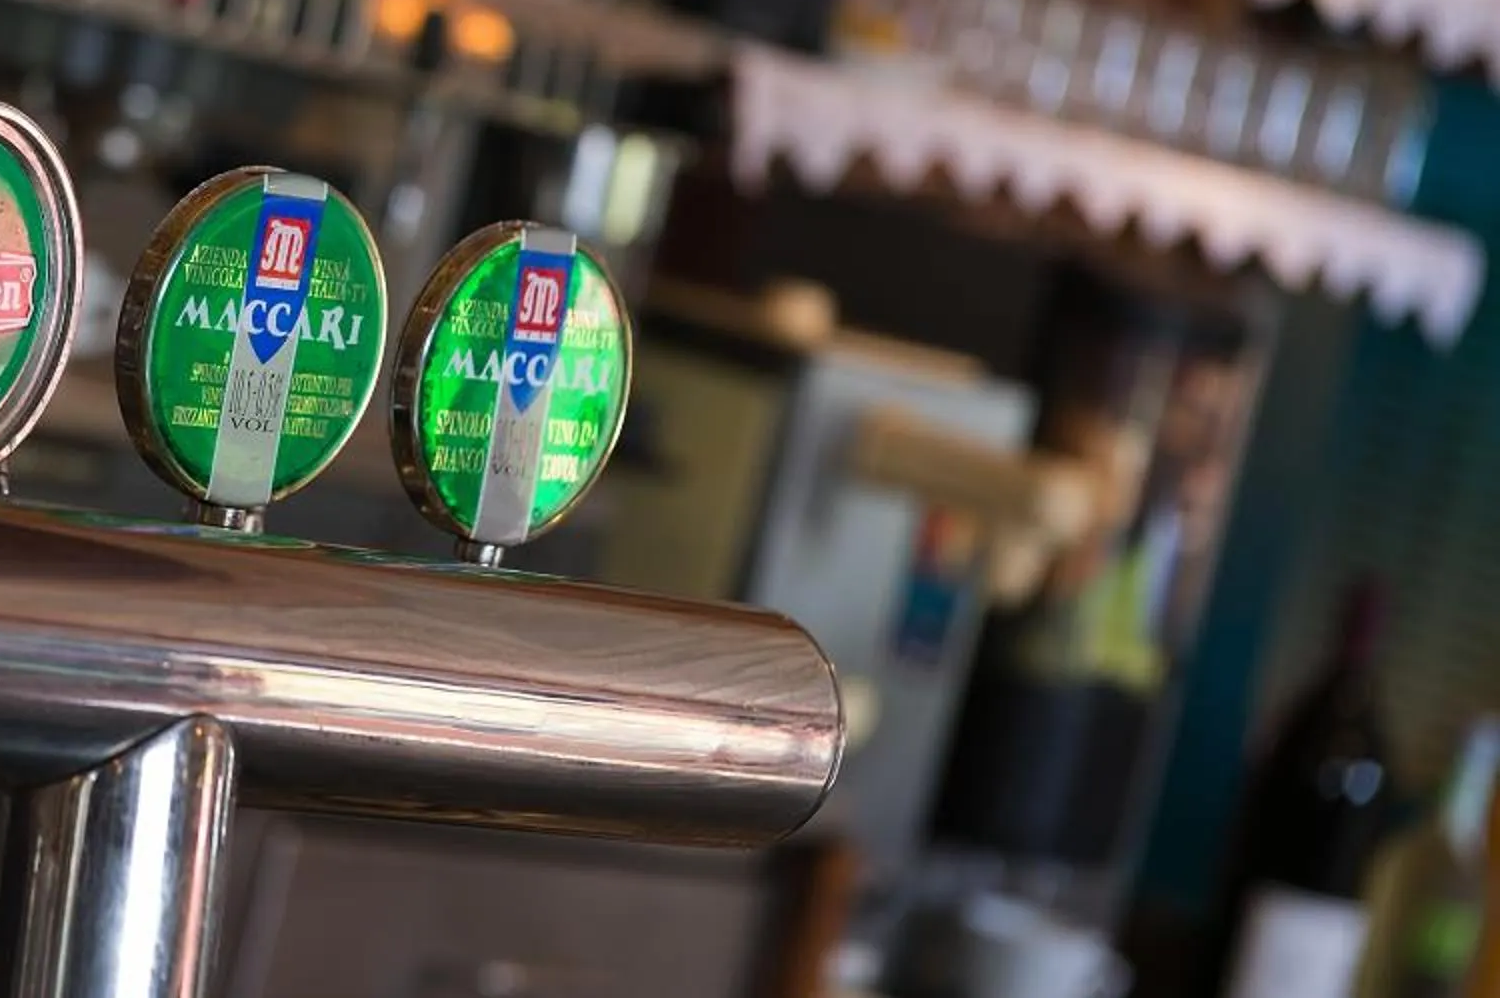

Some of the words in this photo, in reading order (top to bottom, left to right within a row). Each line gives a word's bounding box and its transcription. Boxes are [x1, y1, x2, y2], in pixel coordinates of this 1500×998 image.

[190, 245, 246, 268] AZIENDA
[185, 265, 242, 288] VINICOLA
[175, 296, 364, 350] MACCARI
[442, 348, 613, 395] MACCARI
[232, 419, 273, 432] VOL
